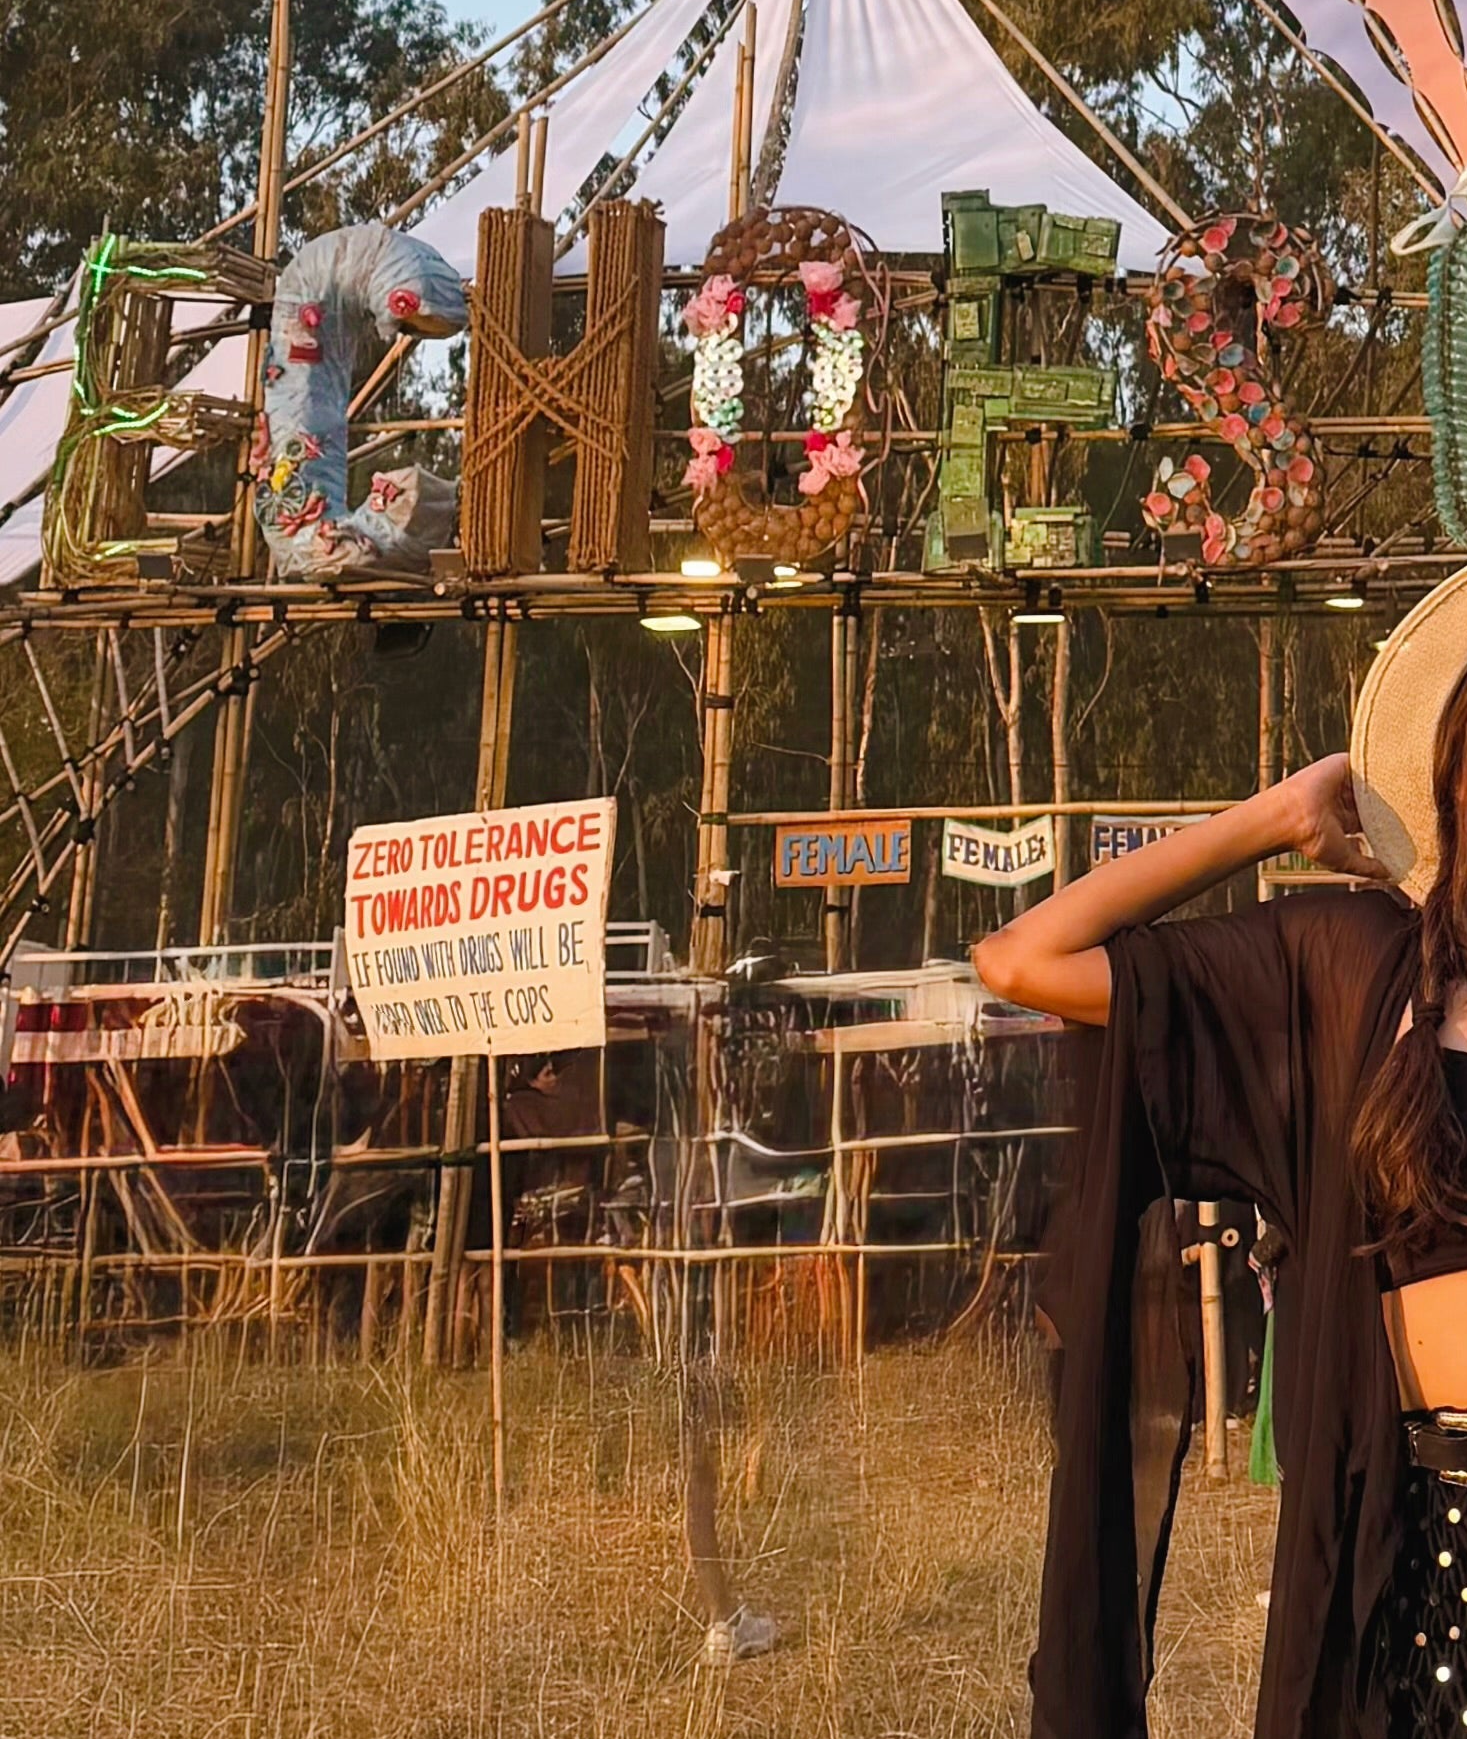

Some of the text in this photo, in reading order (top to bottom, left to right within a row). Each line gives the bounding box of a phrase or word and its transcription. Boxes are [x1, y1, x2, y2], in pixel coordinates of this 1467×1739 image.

[38, 190, 1332, 587] ECHOES
[353, 813, 601, 880] ZERO TOLERANCE
[783, 831, 909, 876] FEMALE
[948, 833, 1039, 873] FEMALE
[351, 864, 588, 939] TOWARDS DRUGS
[352, 952, 369, 988] IF
[375, 945, 420, 986] FOUND
[421, 940, 455, 981] WITH
[459, 932, 504, 976] DRUGS
[509, 926, 549, 971] WILL
[413, 997, 450, 1036] OVER
[445, 994, 469, 1032] TO
[469, 991, 498, 1031] THE
[504, 984, 554, 1026] COPS
